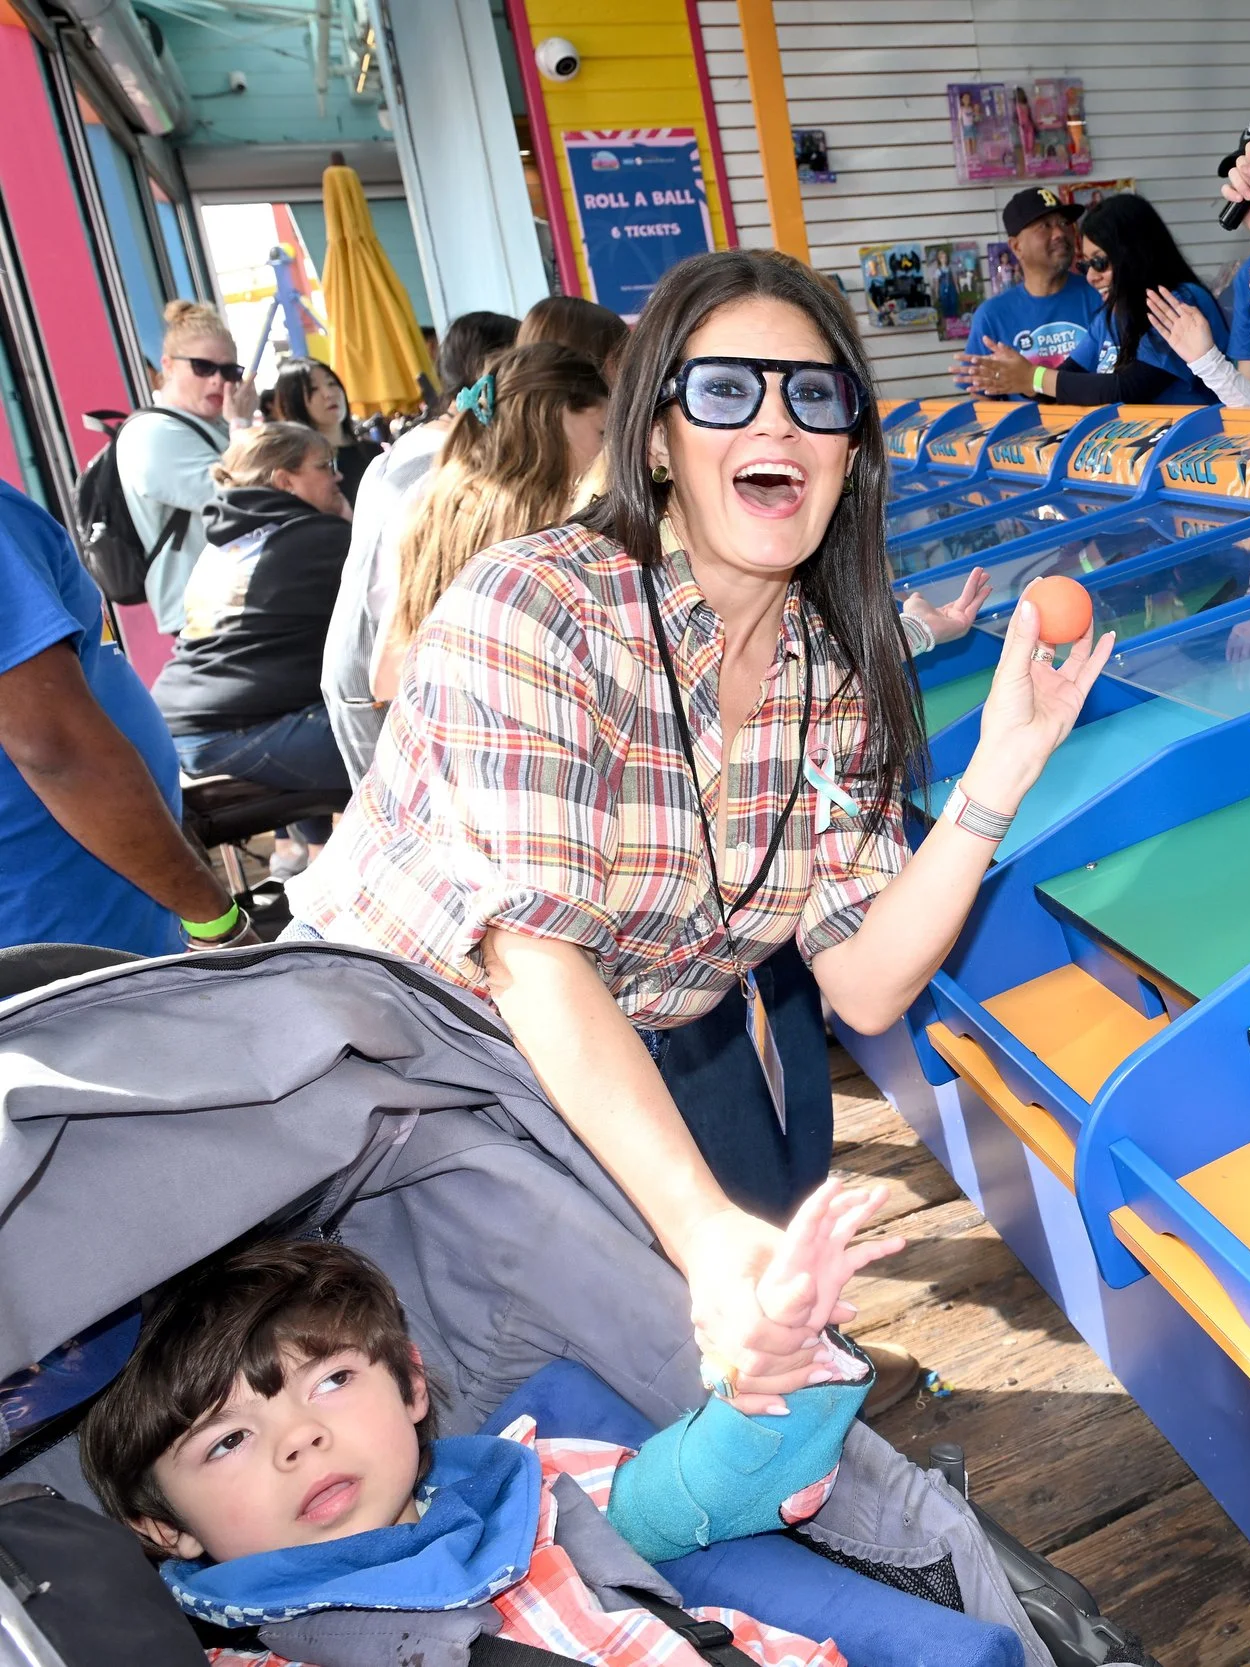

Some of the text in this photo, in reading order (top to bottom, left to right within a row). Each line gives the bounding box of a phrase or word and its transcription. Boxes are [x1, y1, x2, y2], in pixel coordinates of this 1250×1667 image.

[583, 189, 695, 209] ROLL A BALL
[610, 223, 681, 239] 6 TICKETS
[1037, 330, 1075, 346] PARTY
[1048, 341, 1076, 356] PIER
[1074, 439, 1121, 474] BALL
[1166, 451, 1224, 484] BALL
